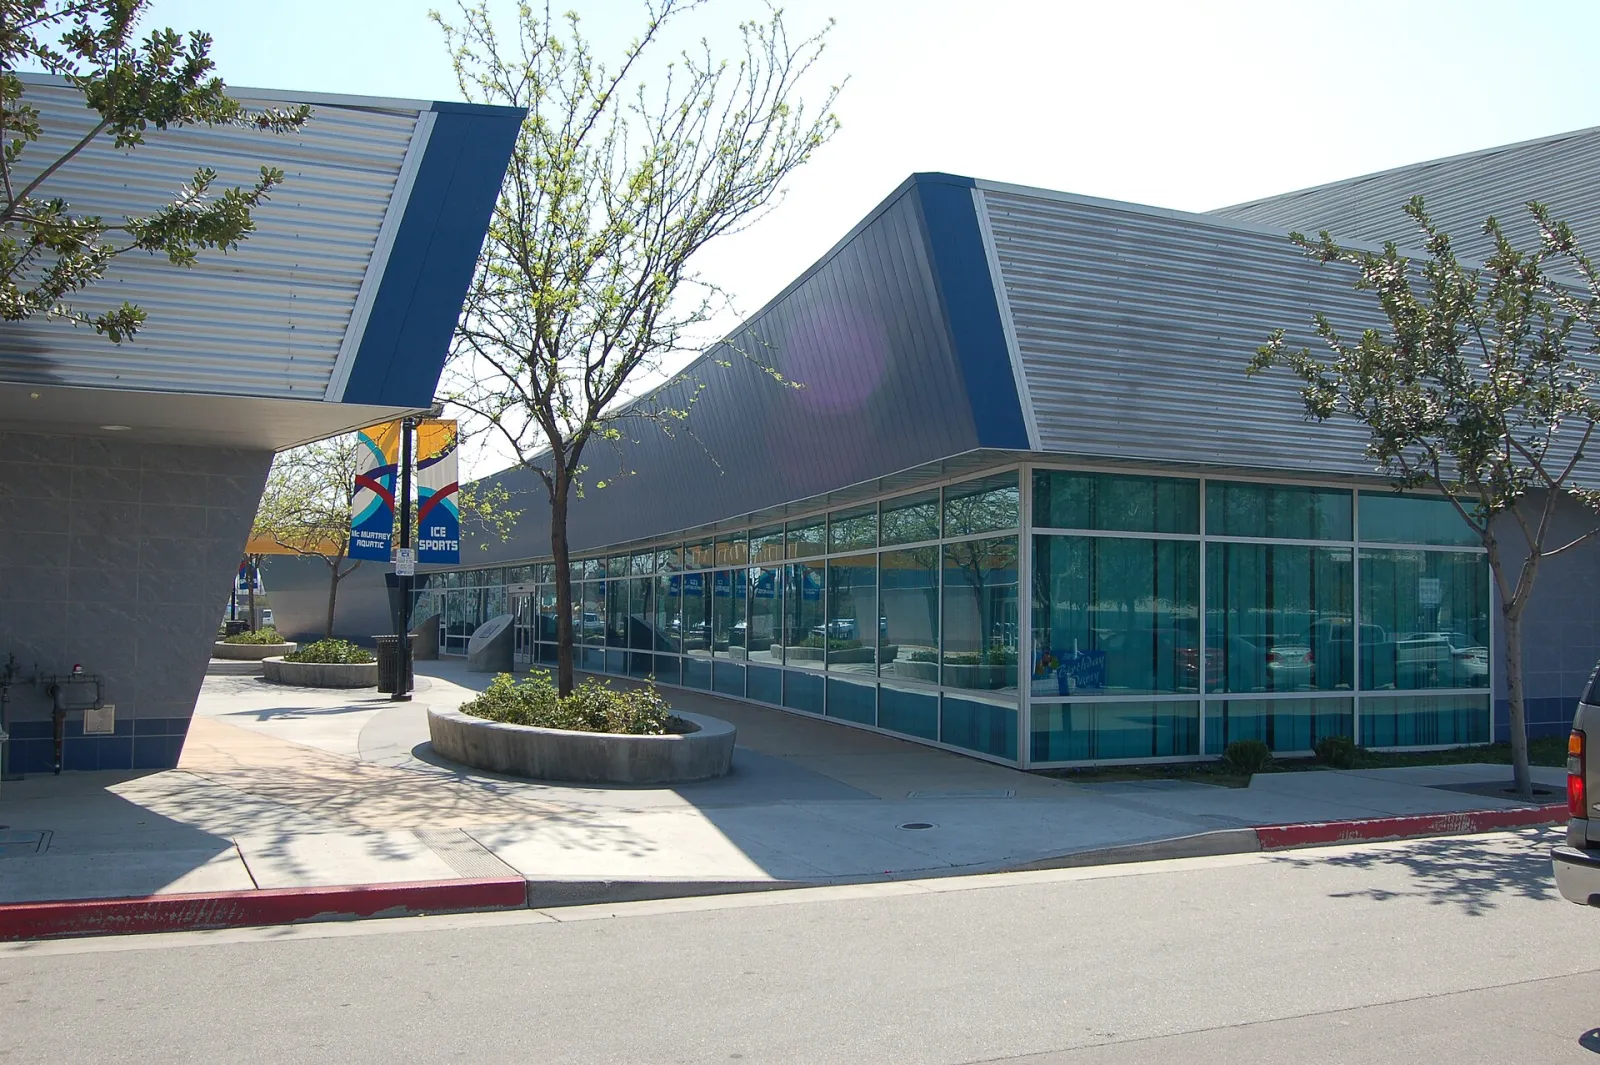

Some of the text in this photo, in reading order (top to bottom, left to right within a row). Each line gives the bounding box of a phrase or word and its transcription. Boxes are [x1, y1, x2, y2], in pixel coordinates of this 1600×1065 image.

[360, 531, 391, 540] MURTREY
[430, 526, 447, 538] ICE
[356, 540, 385, 549] AQUATIC
[418, 540, 458, 551] SPORTS
